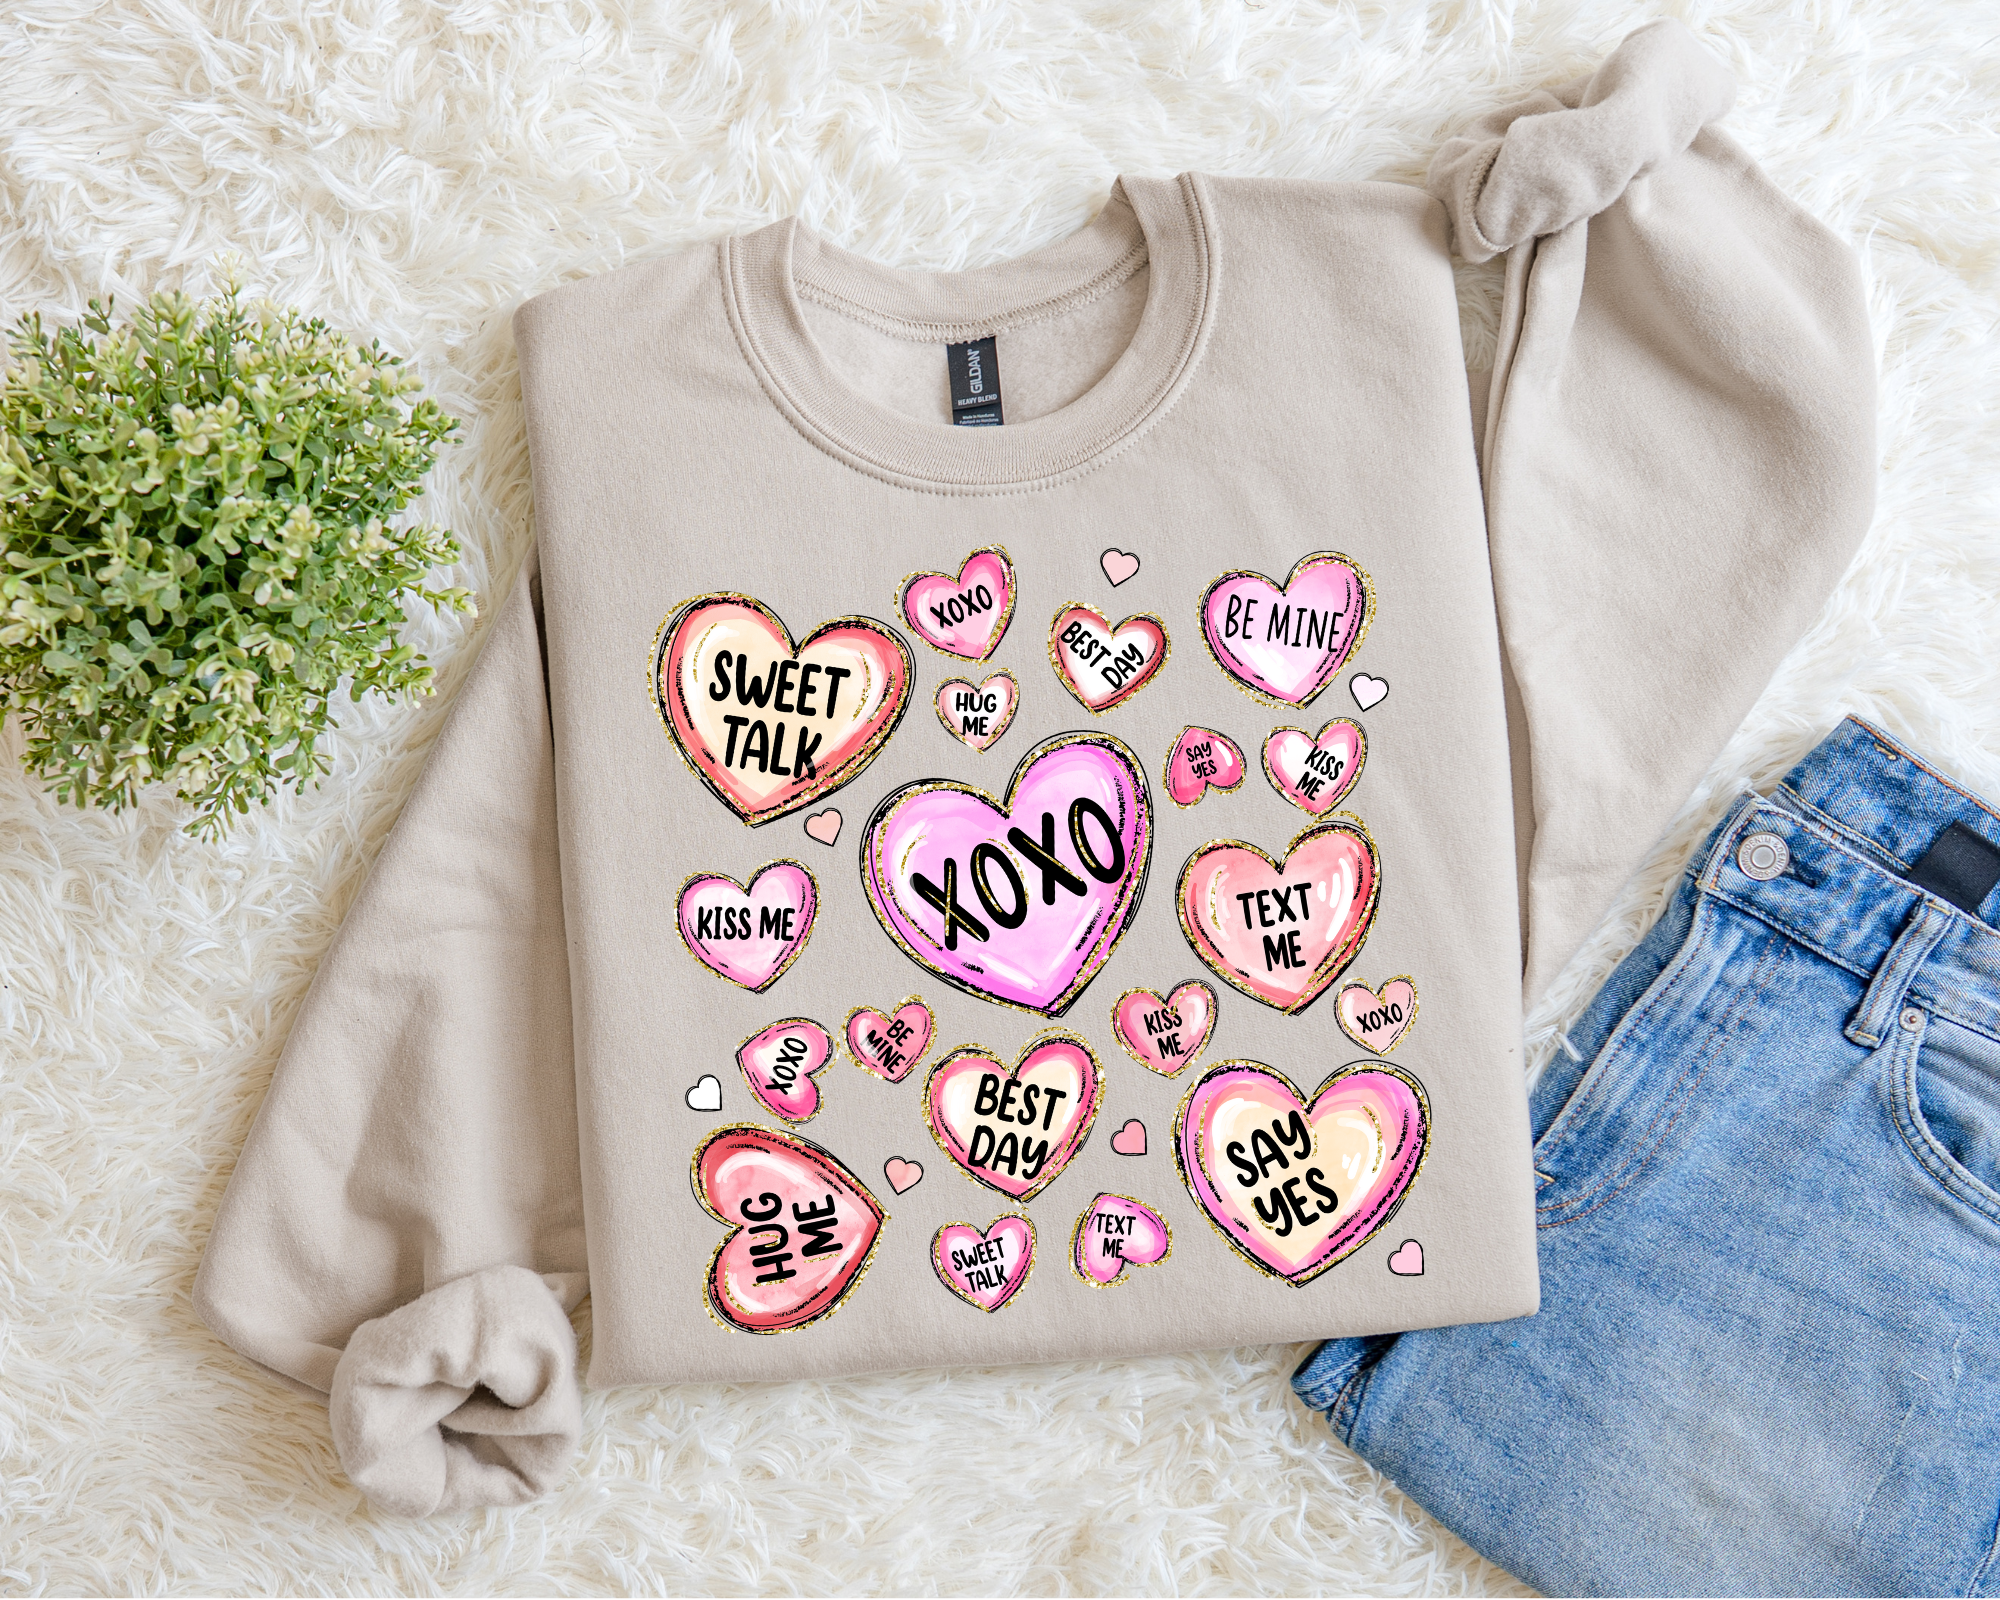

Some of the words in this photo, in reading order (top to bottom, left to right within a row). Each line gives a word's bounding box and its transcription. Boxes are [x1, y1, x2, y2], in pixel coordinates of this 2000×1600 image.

[967, 350, 983, 394] GILDAN
[957, 397, 977, 406] HEAVY
[977, 393, 998, 403] BLEND
[930, 585, 993, 629] XOXO
[1225, 594, 1258, 639] BE
[1267, 603, 1344, 653] MINE
[1061, 621, 1111, 668] BEST
[709, 650, 850, 719] SWEET
[1101, 643, 1145, 690] DAY
[955, 693, 997, 712] HUG
[962, 716, 988, 736] ME
[723, 715, 822, 780] TALK
[1186, 741, 1211, 763] SAY
[1305, 745, 1344, 780] KISS
[1192, 759, 1217, 779] YES
[1295, 772, 1326, 801] ME
[909, 797, 1126, 951] XOXO
[698, 906, 751, 940] KISS
[759, 906, 795, 941] ME
[1236, 882, 1312, 930] TEXT
[1262, 931, 1306, 972] ME
[886, 1019, 914, 1048] BE
[1144, 1008, 1183, 1036] KISS
[1356, 1003, 1402, 1033] XOXO
[765, 1038, 808, 1095] XOXO
[862, 1029, 906, 1074] MINE
[1157, 1033, 1184, 1060] ME
[973, 1074, 1067, 1131] BEST
[968, 1126, 1048, 1179] DAY
[1226, 1110, 1312, 1188] SAY
[1253, 1167, 1338, 1237] YES
[740, 1192, 797, 1283] HUG
[792, 1194, 843, 1260] ME
[1097, 1213, 1136, 1236] TEXT
[951, 1237, 1005, 1272] SWEET
[1102, 1239, 1124, 1258] ME
[965, 1264, 1008, 1293] TALK
